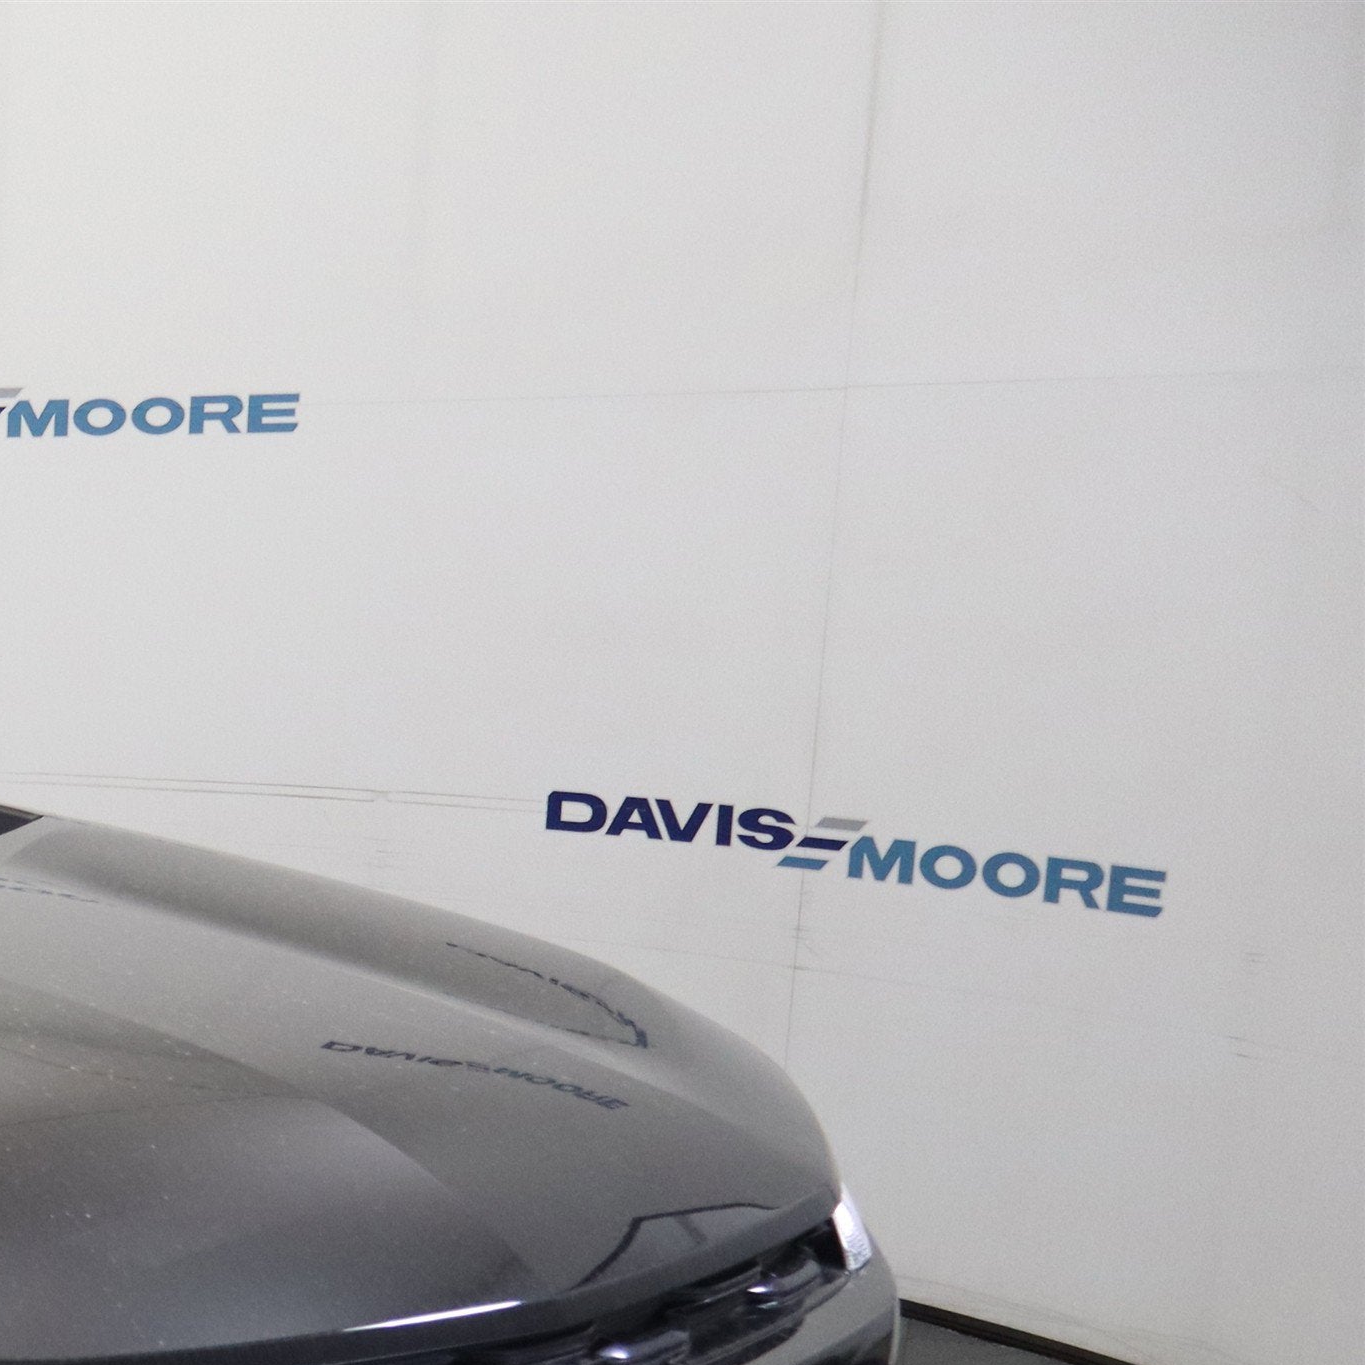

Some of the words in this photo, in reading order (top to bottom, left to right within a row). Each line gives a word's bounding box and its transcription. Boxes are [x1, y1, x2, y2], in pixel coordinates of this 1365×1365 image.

[6, 393, 301, 438] MOORE
[545, 791, 796, 851] DAVIS
[846, 836, 1167, 918] MOORE
